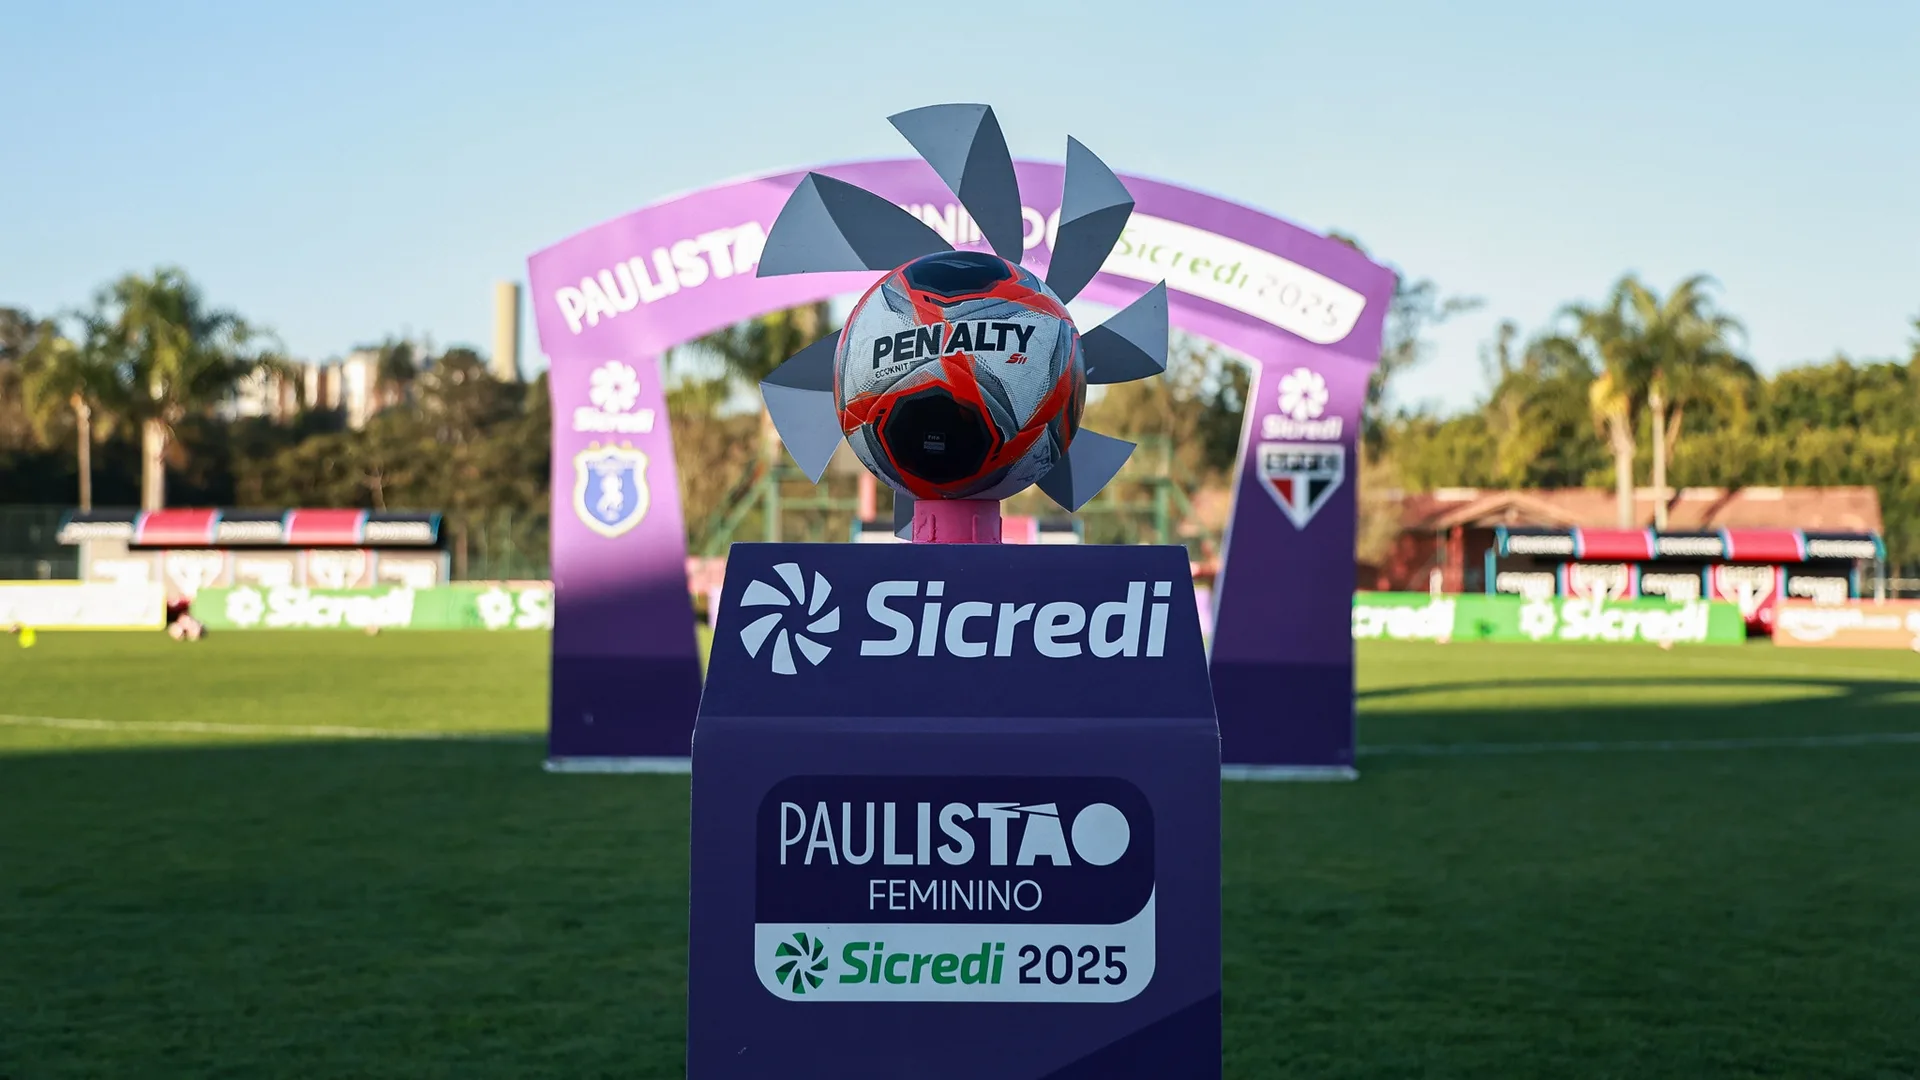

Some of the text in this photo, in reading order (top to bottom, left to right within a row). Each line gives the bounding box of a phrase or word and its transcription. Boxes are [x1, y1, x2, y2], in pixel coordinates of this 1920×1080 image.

[554, 220, 768, 334] PAULISTA
[872, 322, 1036, 370] PENALTY
[860, 580, 1173, 659] Sicredi
[869, 879, 1042, 911] FEMININO
[839, 941, 1128, 985] Sicredi 2025
